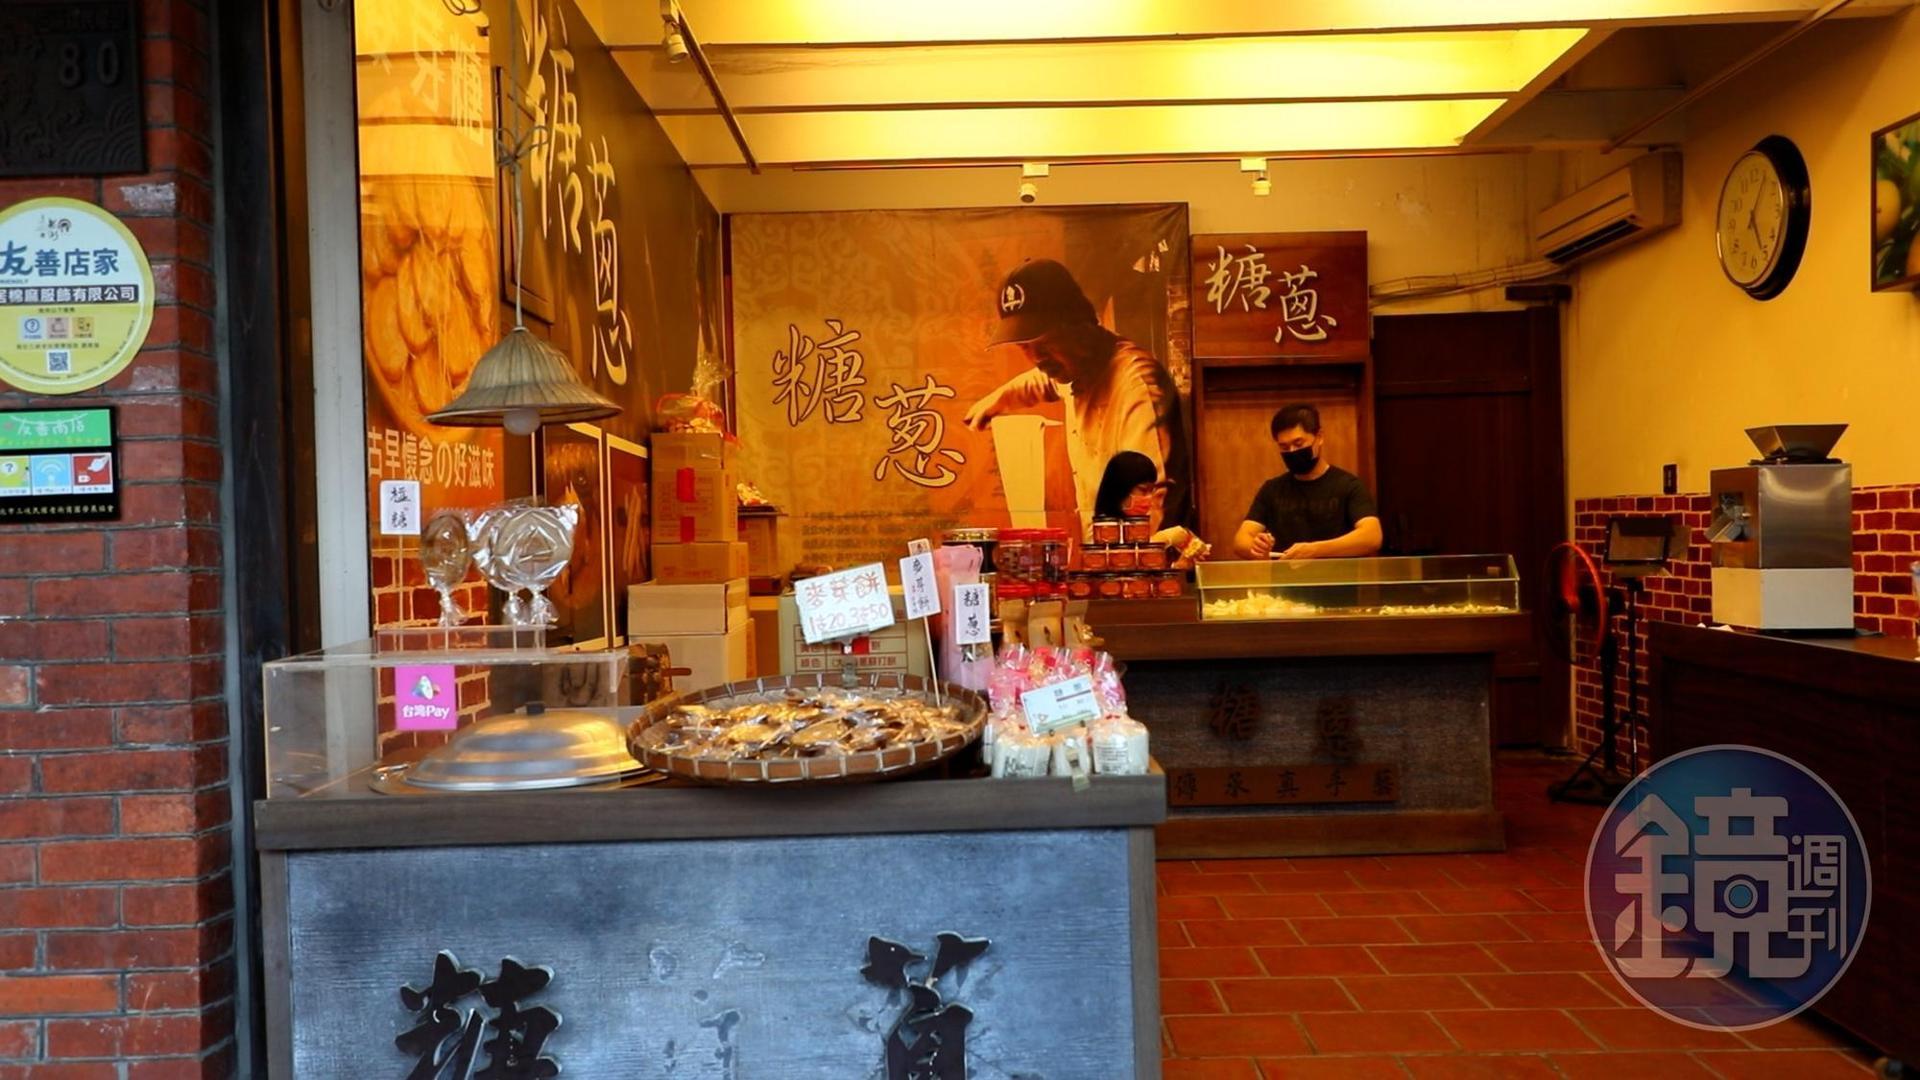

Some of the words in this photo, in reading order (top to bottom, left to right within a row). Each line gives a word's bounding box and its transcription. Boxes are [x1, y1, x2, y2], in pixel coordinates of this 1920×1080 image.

[59, 39, 119, 87] 80
[0, 241, 119, 277] 友善店家
[402, 704, 450, 720] 台灣Pay
